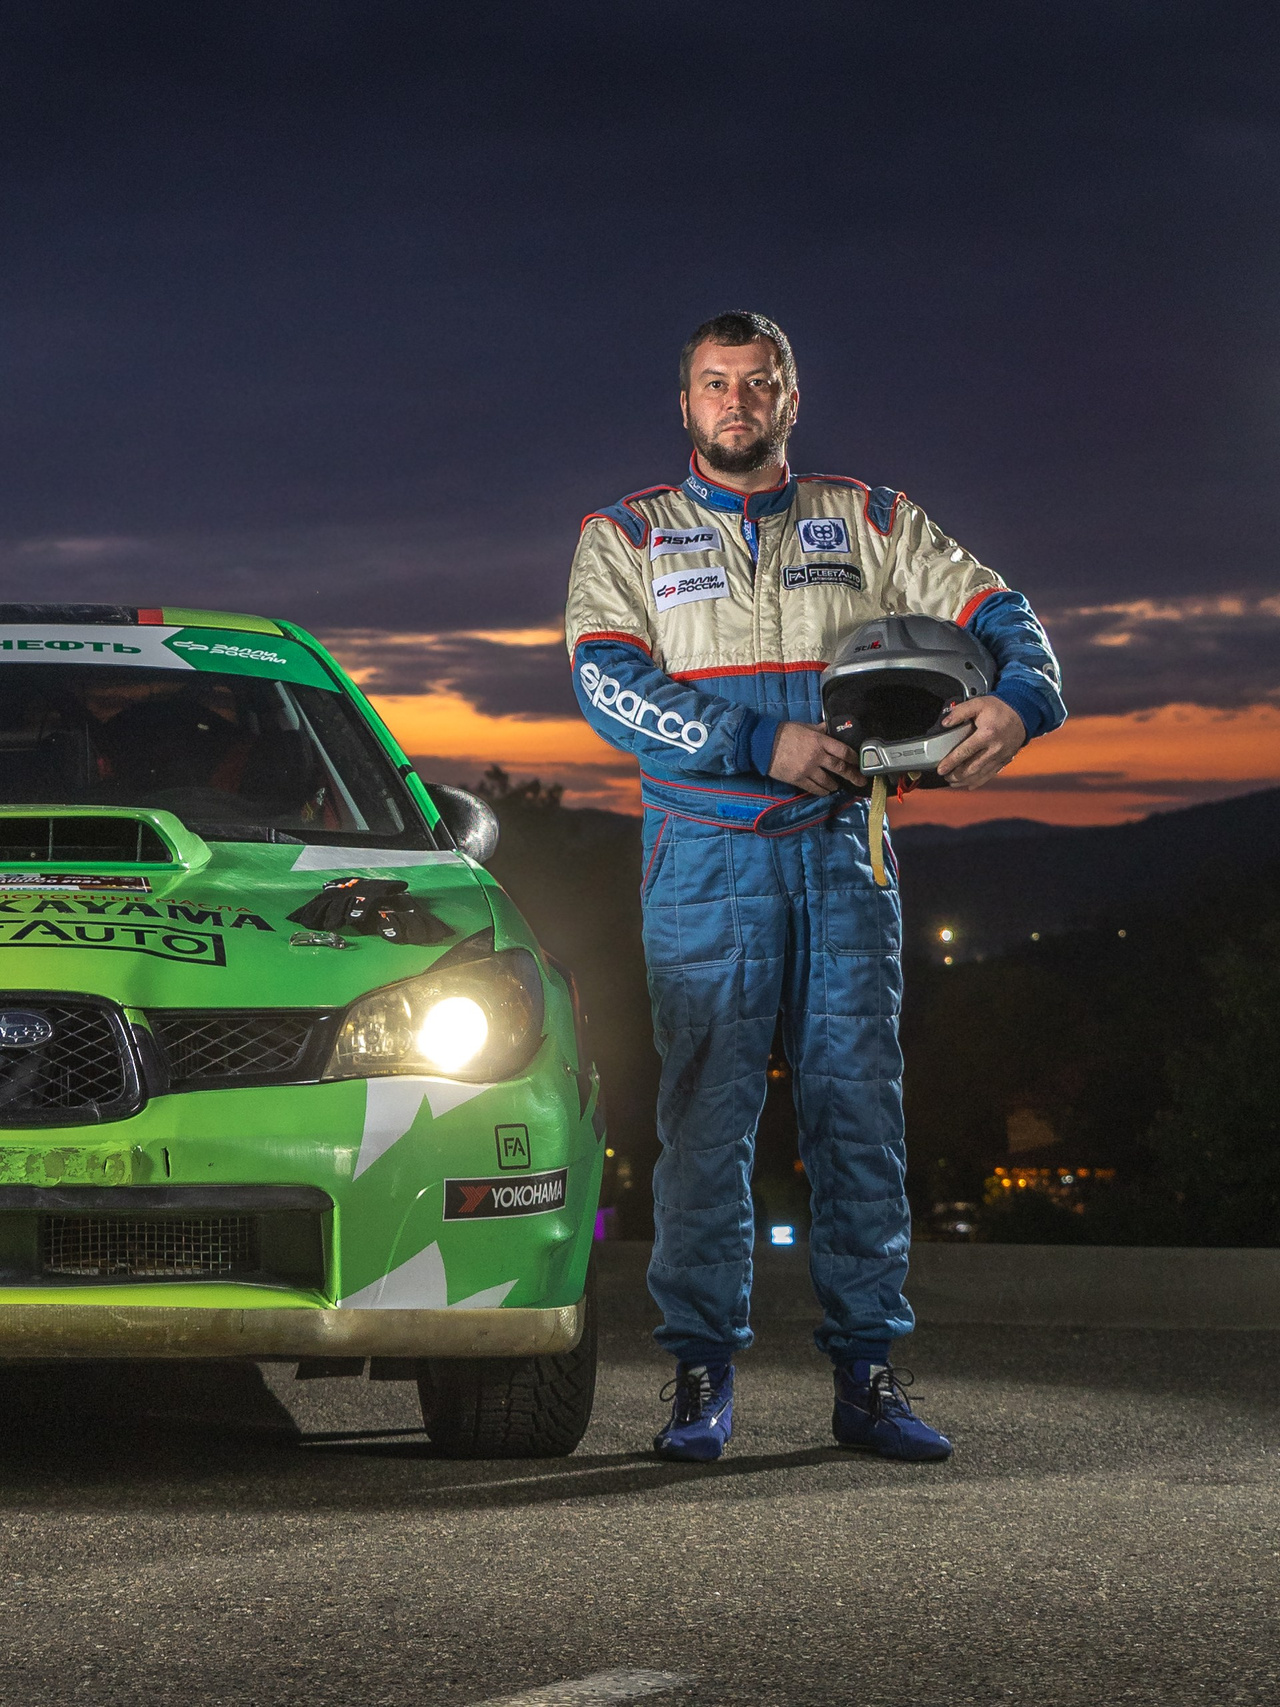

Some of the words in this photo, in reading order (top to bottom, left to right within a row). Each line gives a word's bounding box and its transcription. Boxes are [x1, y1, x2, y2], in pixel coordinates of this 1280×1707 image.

[678, 575, 718, 588] РАЛЛИ
[788, 572, 805, 582] FA
[676, 582, 725, 595] РОССИИ
[208, 648, 287, 664] РОССИИ
[580, 662, 708, 749] sparco
[156, 898, 254, 913] МАСЛА
[504, 1137, 526, 1157] FA
[491, 1179, 563, 1209] YOKOHAMA
